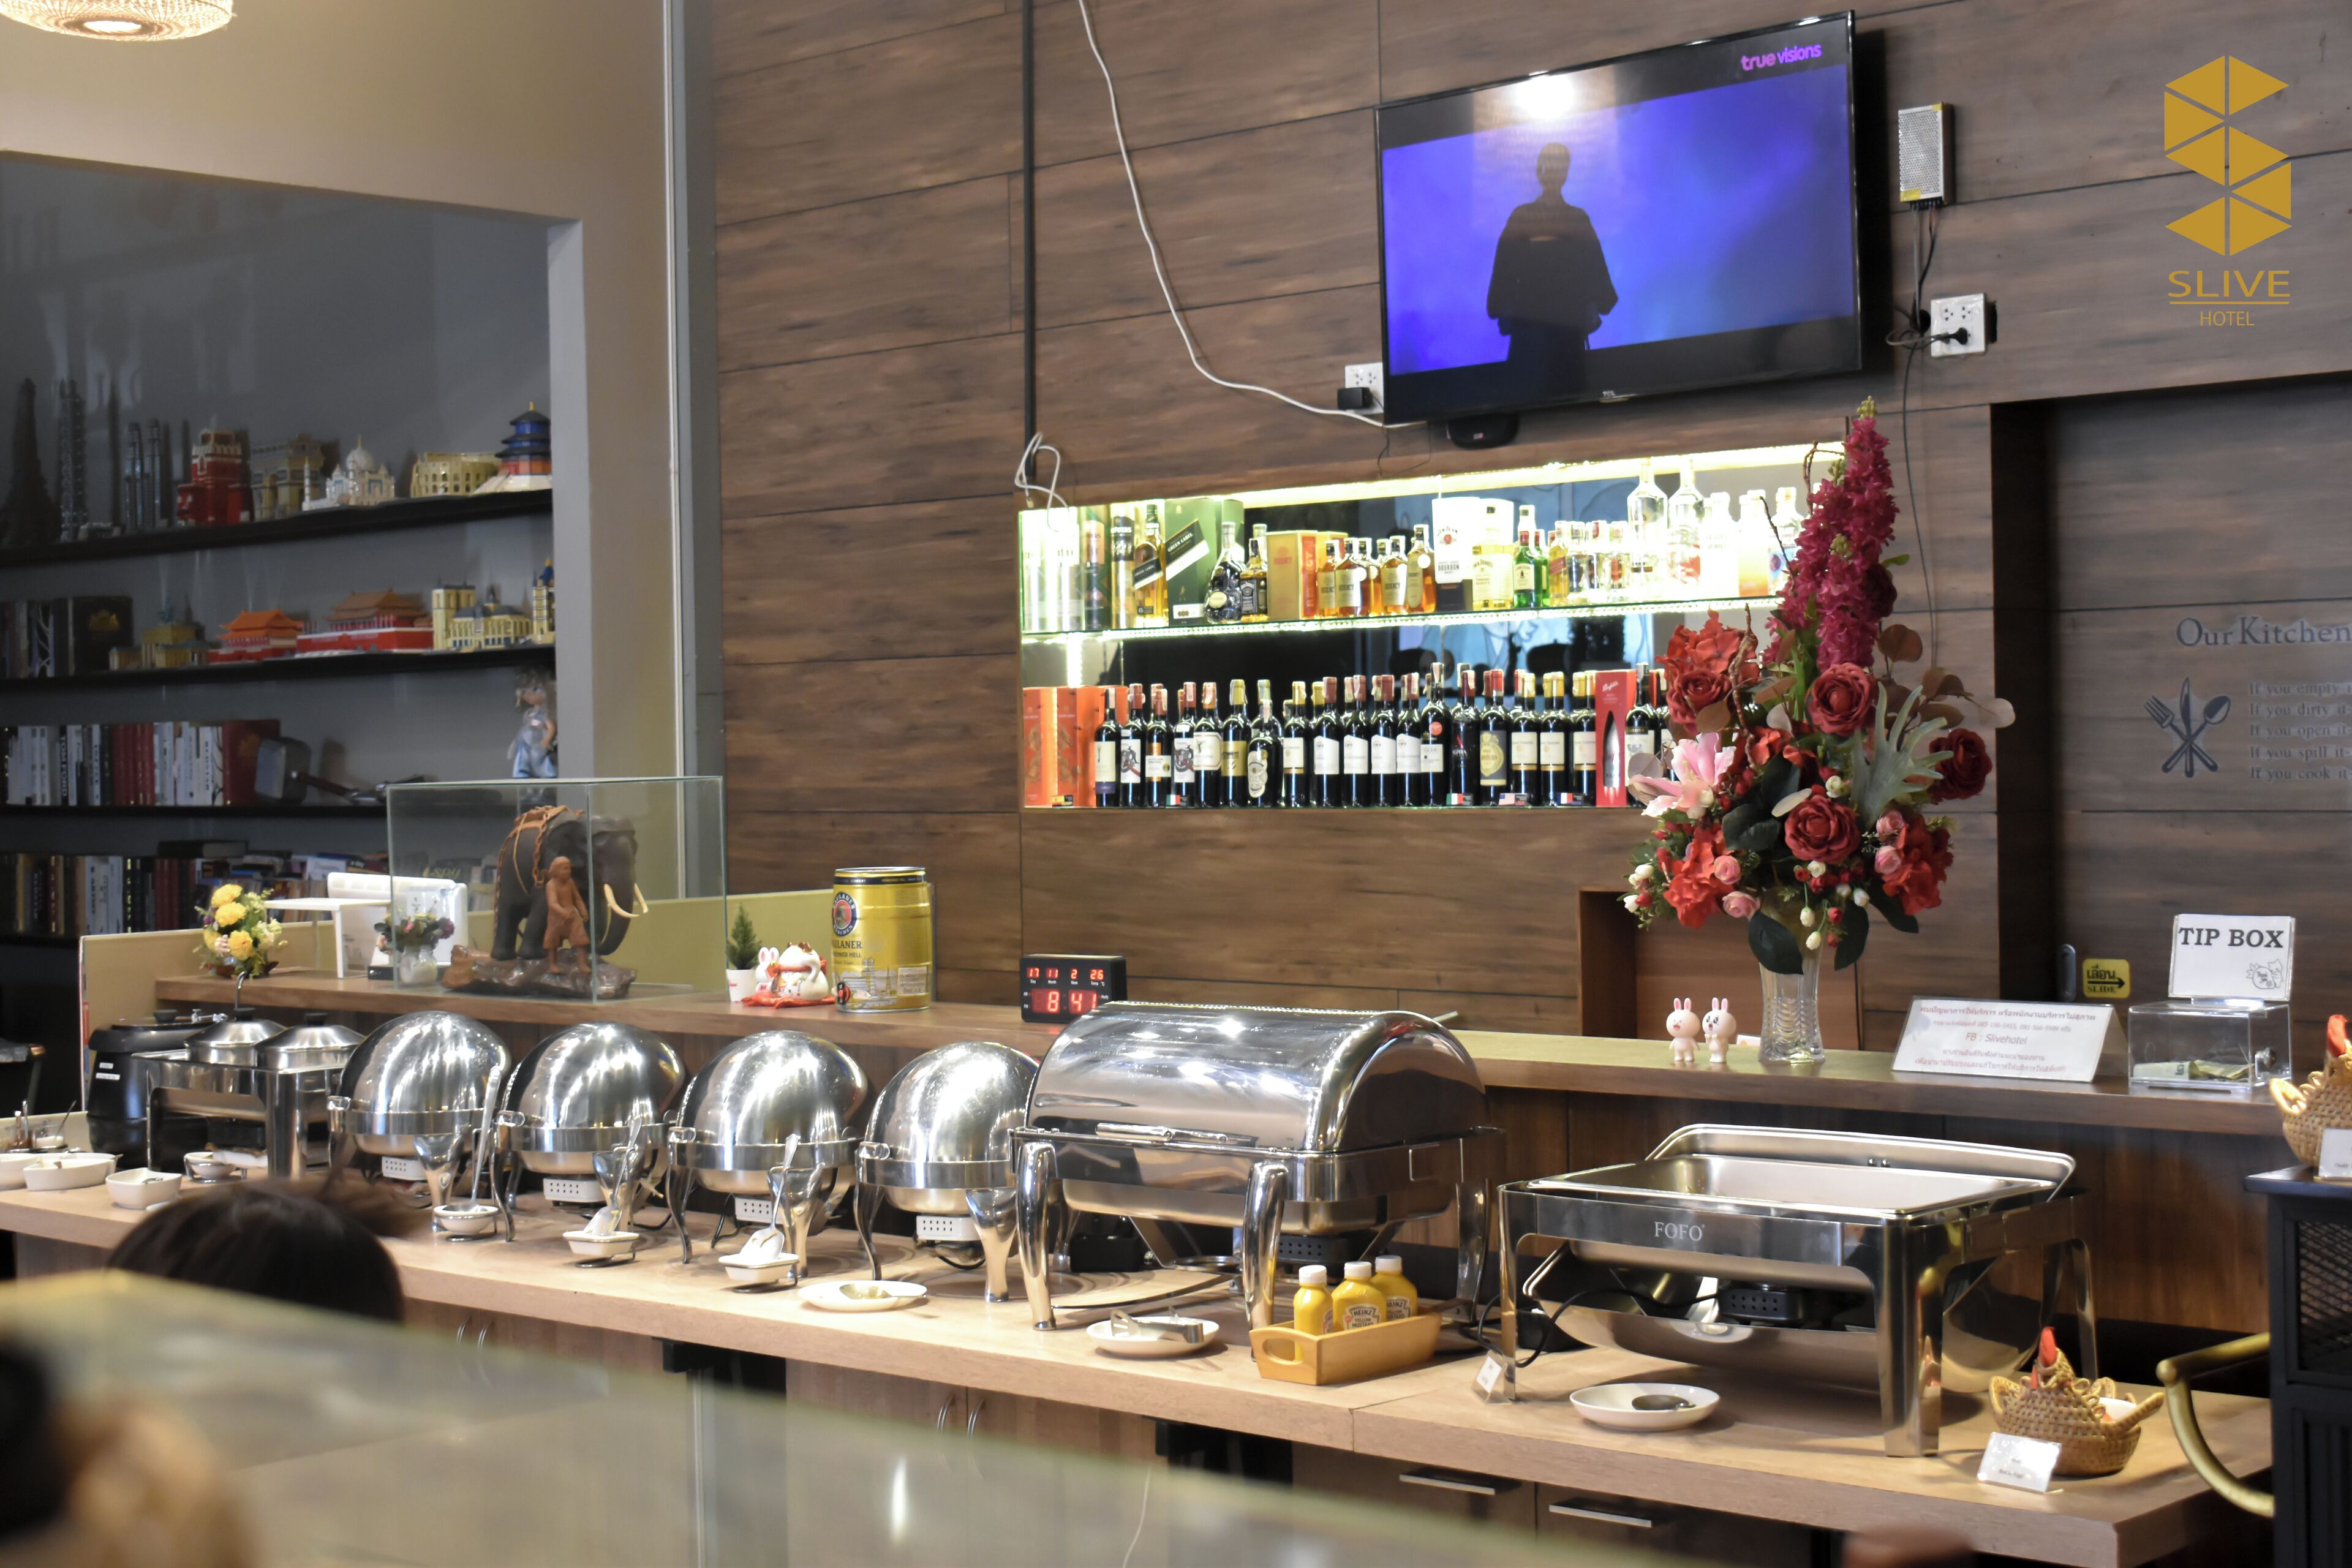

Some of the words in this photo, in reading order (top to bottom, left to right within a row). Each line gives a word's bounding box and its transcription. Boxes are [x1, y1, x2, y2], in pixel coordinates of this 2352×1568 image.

[1741, 53, 1776, 71] true
[1777, 43, 1822, 64] visions
[2177, 617, 2233, 647] Our
[2239, 616, 2351, 644] Kitchen
[2267, 685, 2291, 696] you
[2267, 706, 2291, 718] you
[2297, 703, 2328, 718] dirty
[2267, 728, 2291, 739] you
[2297, 726, 2330, 739] open
[2267, 748, 2291, 761] you
[2298, 745, 2327, 761] spill
[2267, 769, 2292, 782] you
[2297, 766, 2331, 779] cook
[2178, 927, 2220, 946] TIP
[2228, 929, 2284, 948] BOX
[1029, 968, 1040, 978] 17
[1048, 968, 1058, 978] 11
[1071, 968, 1078, 979] 2
[1090, 970, 1104, 981] 26
[2087, 963, 2116, 980] เลื่อน
[1966, 1033, 1977, 1041] FB
[1985, 1033, 2027, 1045] Slivehotel
